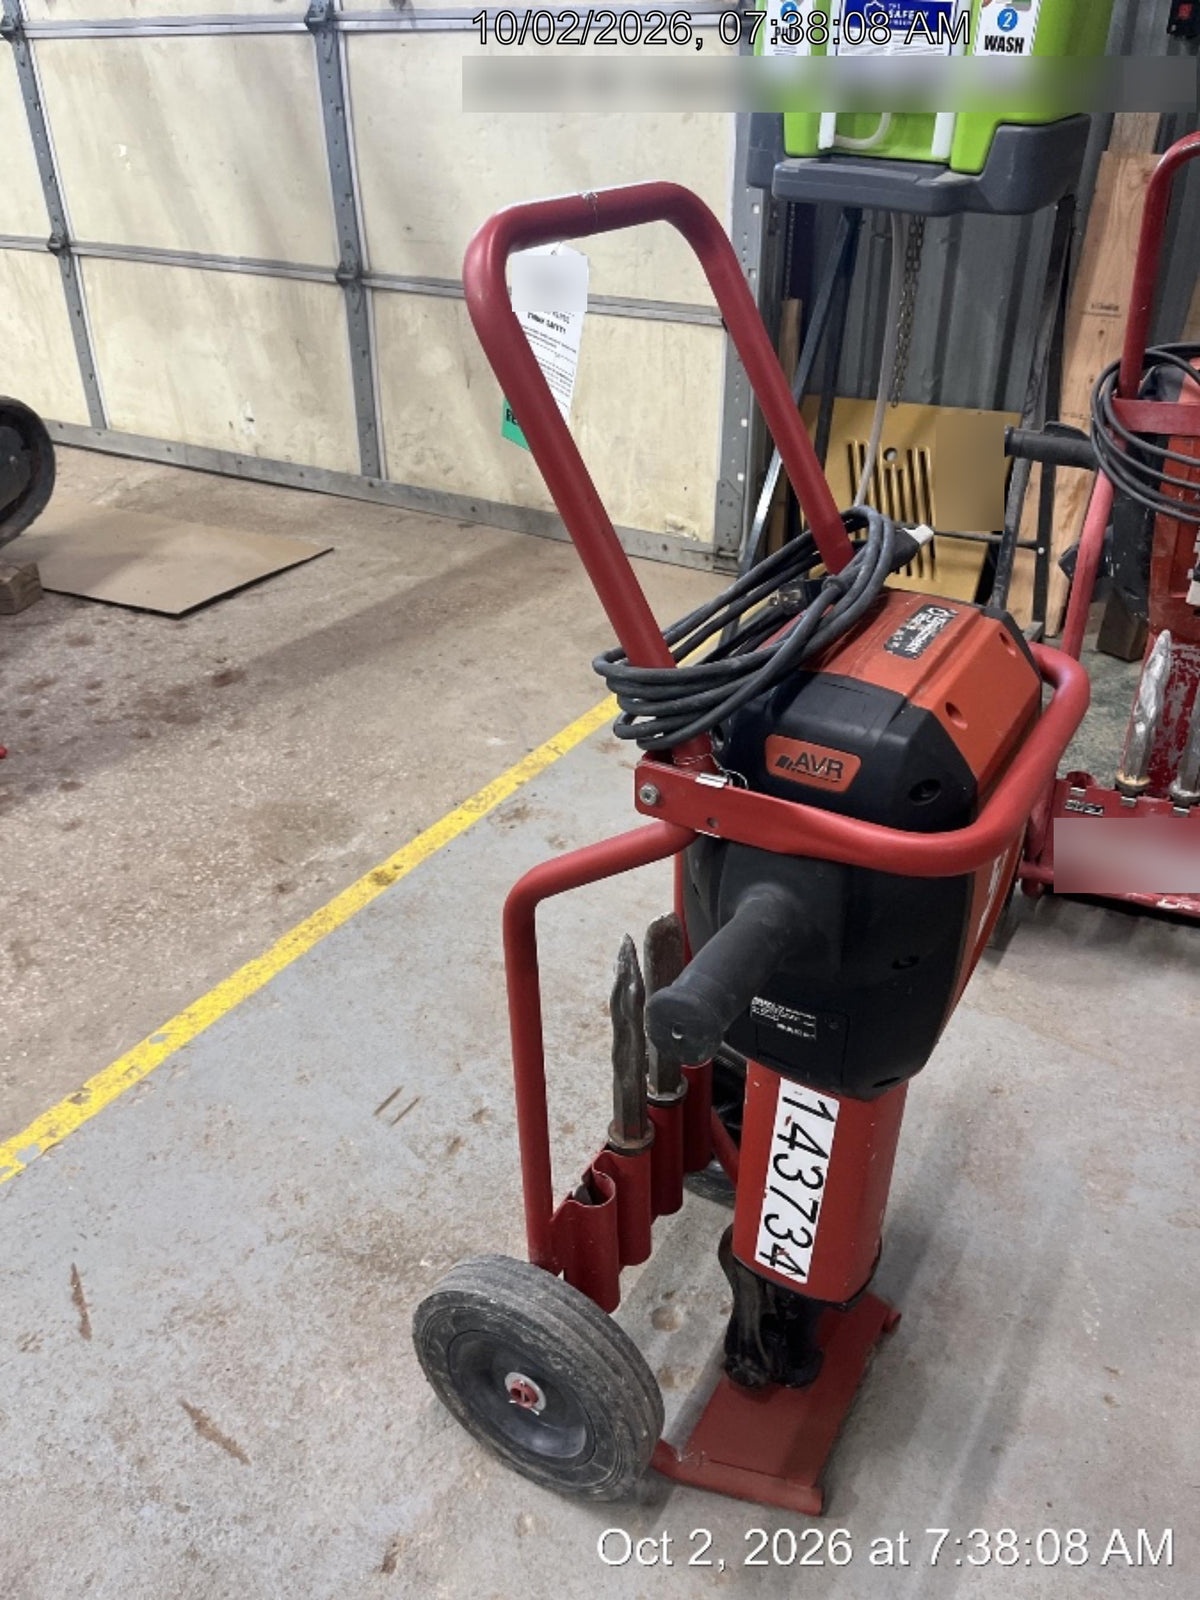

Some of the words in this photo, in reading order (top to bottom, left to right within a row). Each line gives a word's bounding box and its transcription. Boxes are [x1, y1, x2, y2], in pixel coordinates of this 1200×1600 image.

[889, 10, 929, 20] SAFEY
[1001, 12, 1012, 28] 2
[984, 35, 1025, 53] WASH
[794, 751, 844, 780] AVR
[758, 1096, 837, 1278] 143734
